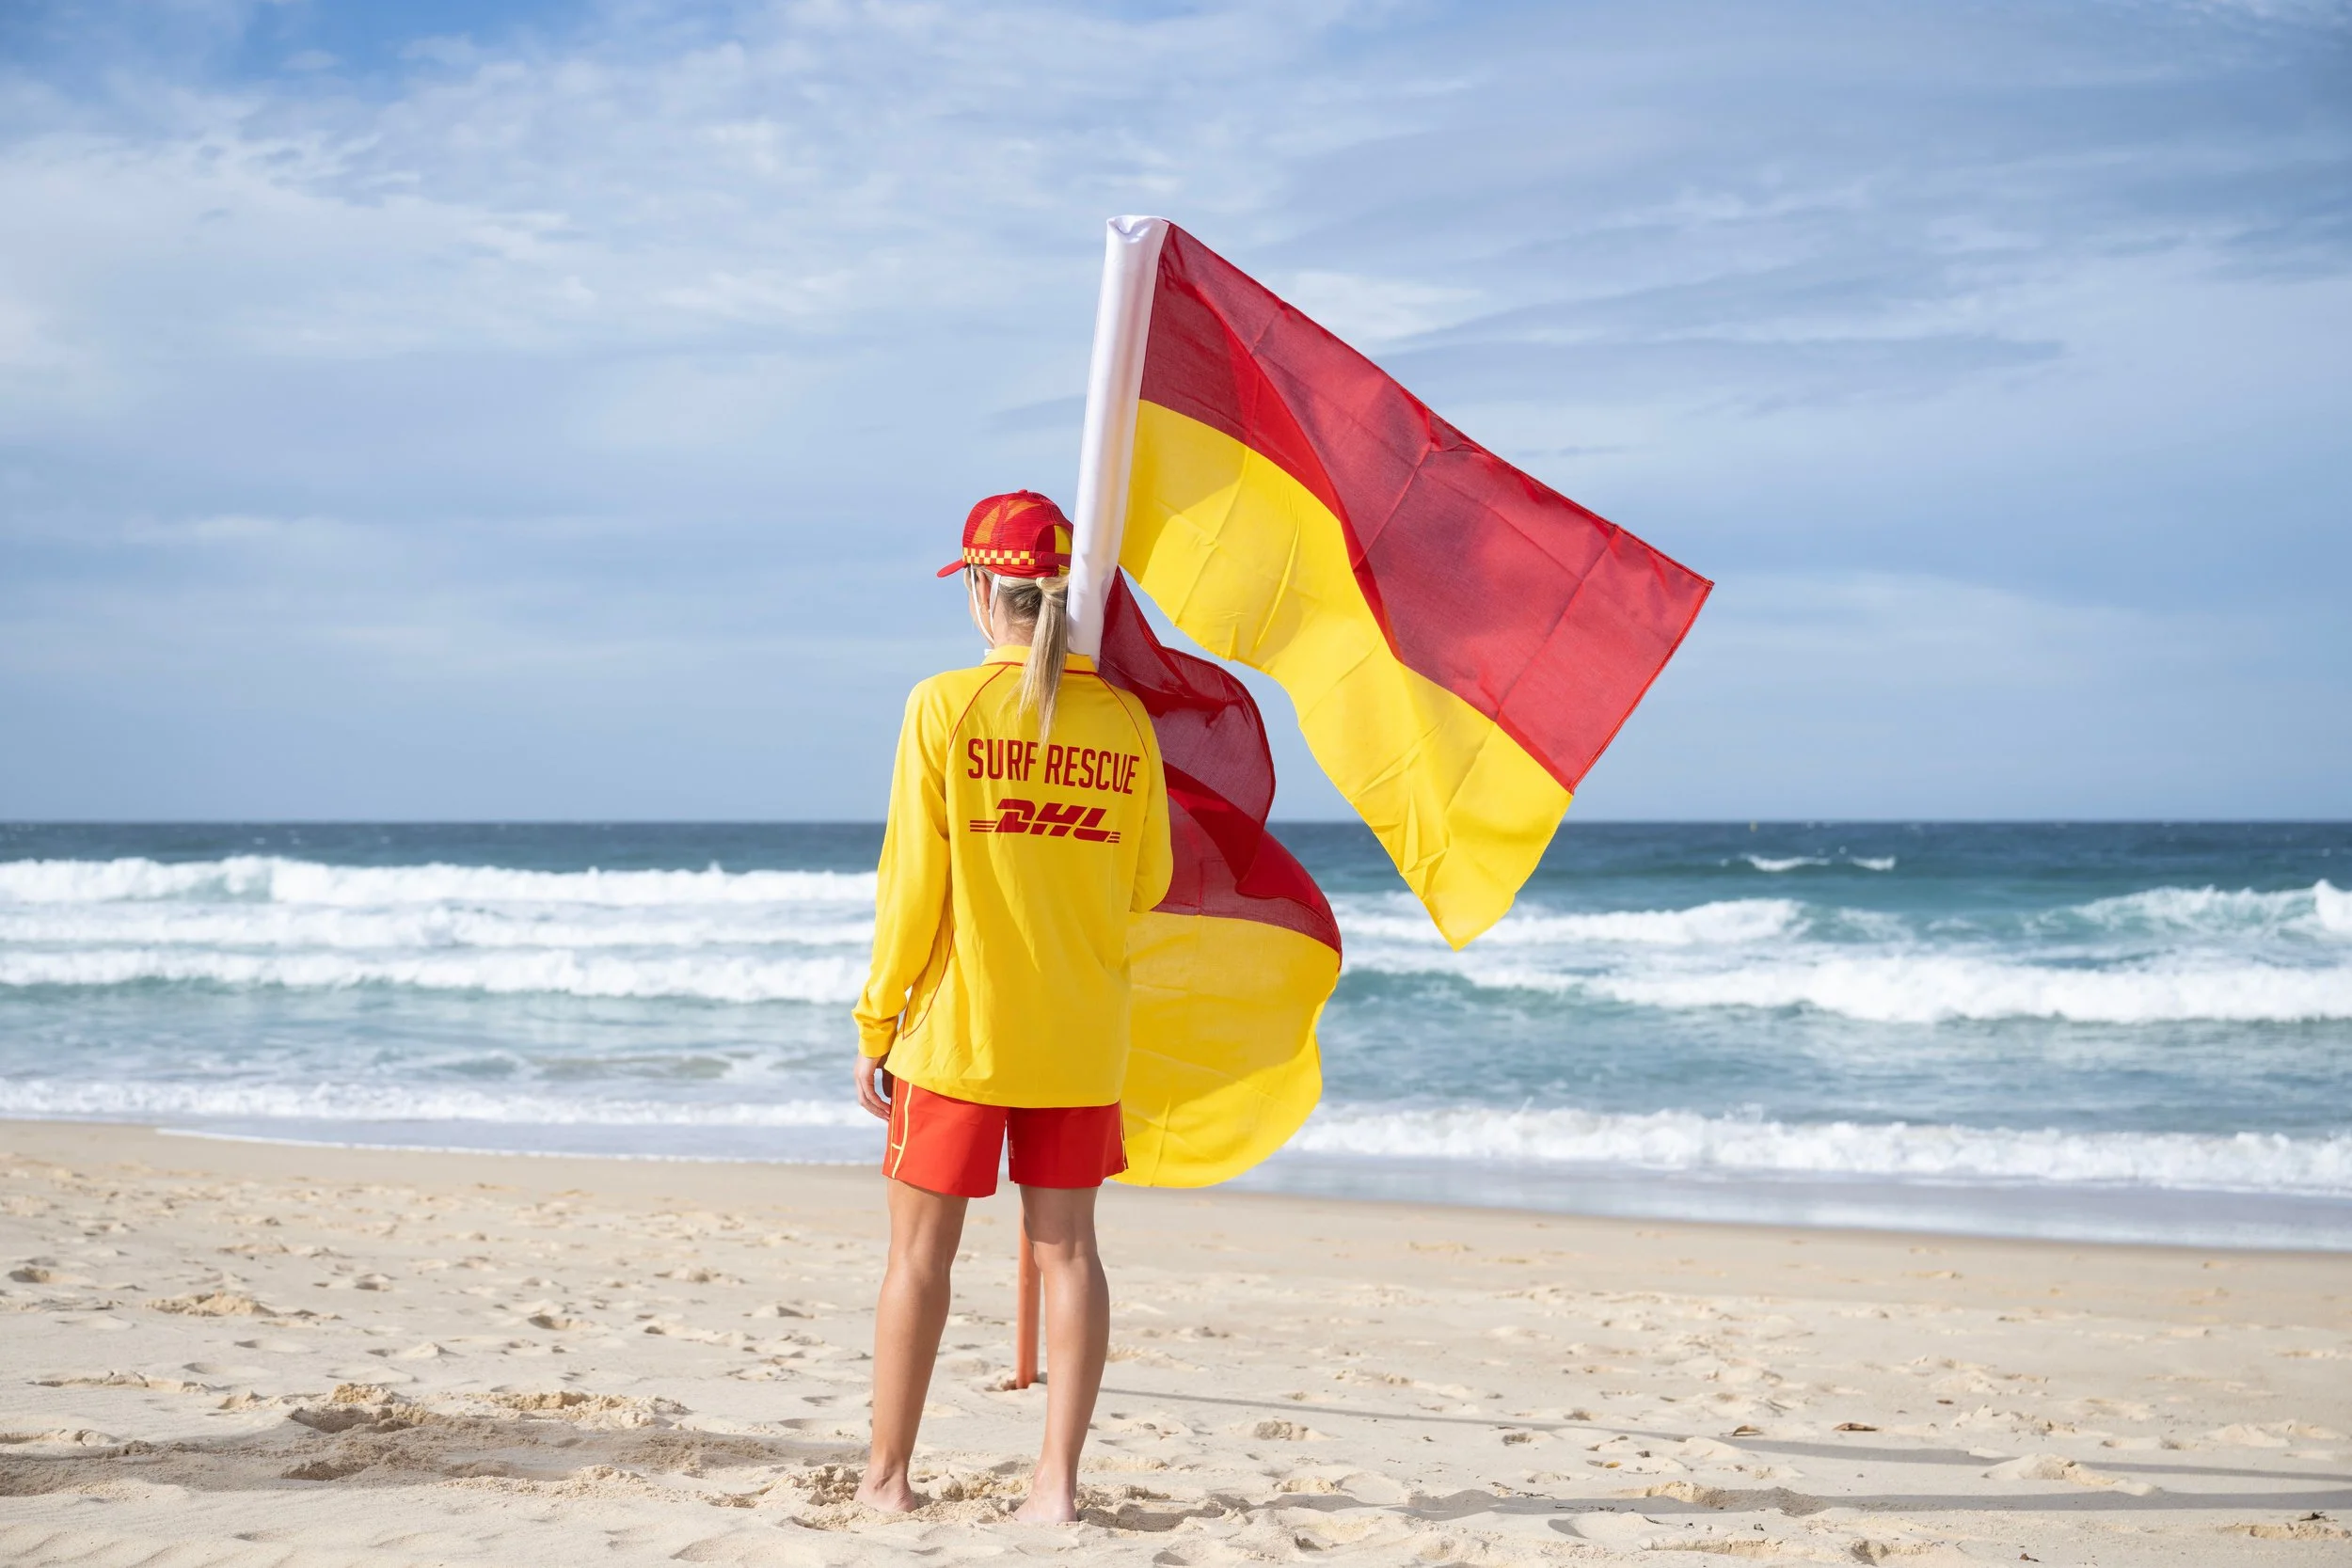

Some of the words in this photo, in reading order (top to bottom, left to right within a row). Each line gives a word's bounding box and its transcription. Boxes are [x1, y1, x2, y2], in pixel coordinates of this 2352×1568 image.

[968, 738, 1039, 782] SURF
[1044, 744, 1140, 795] RESCUE
[994, 798, 1111, 843] DHL
